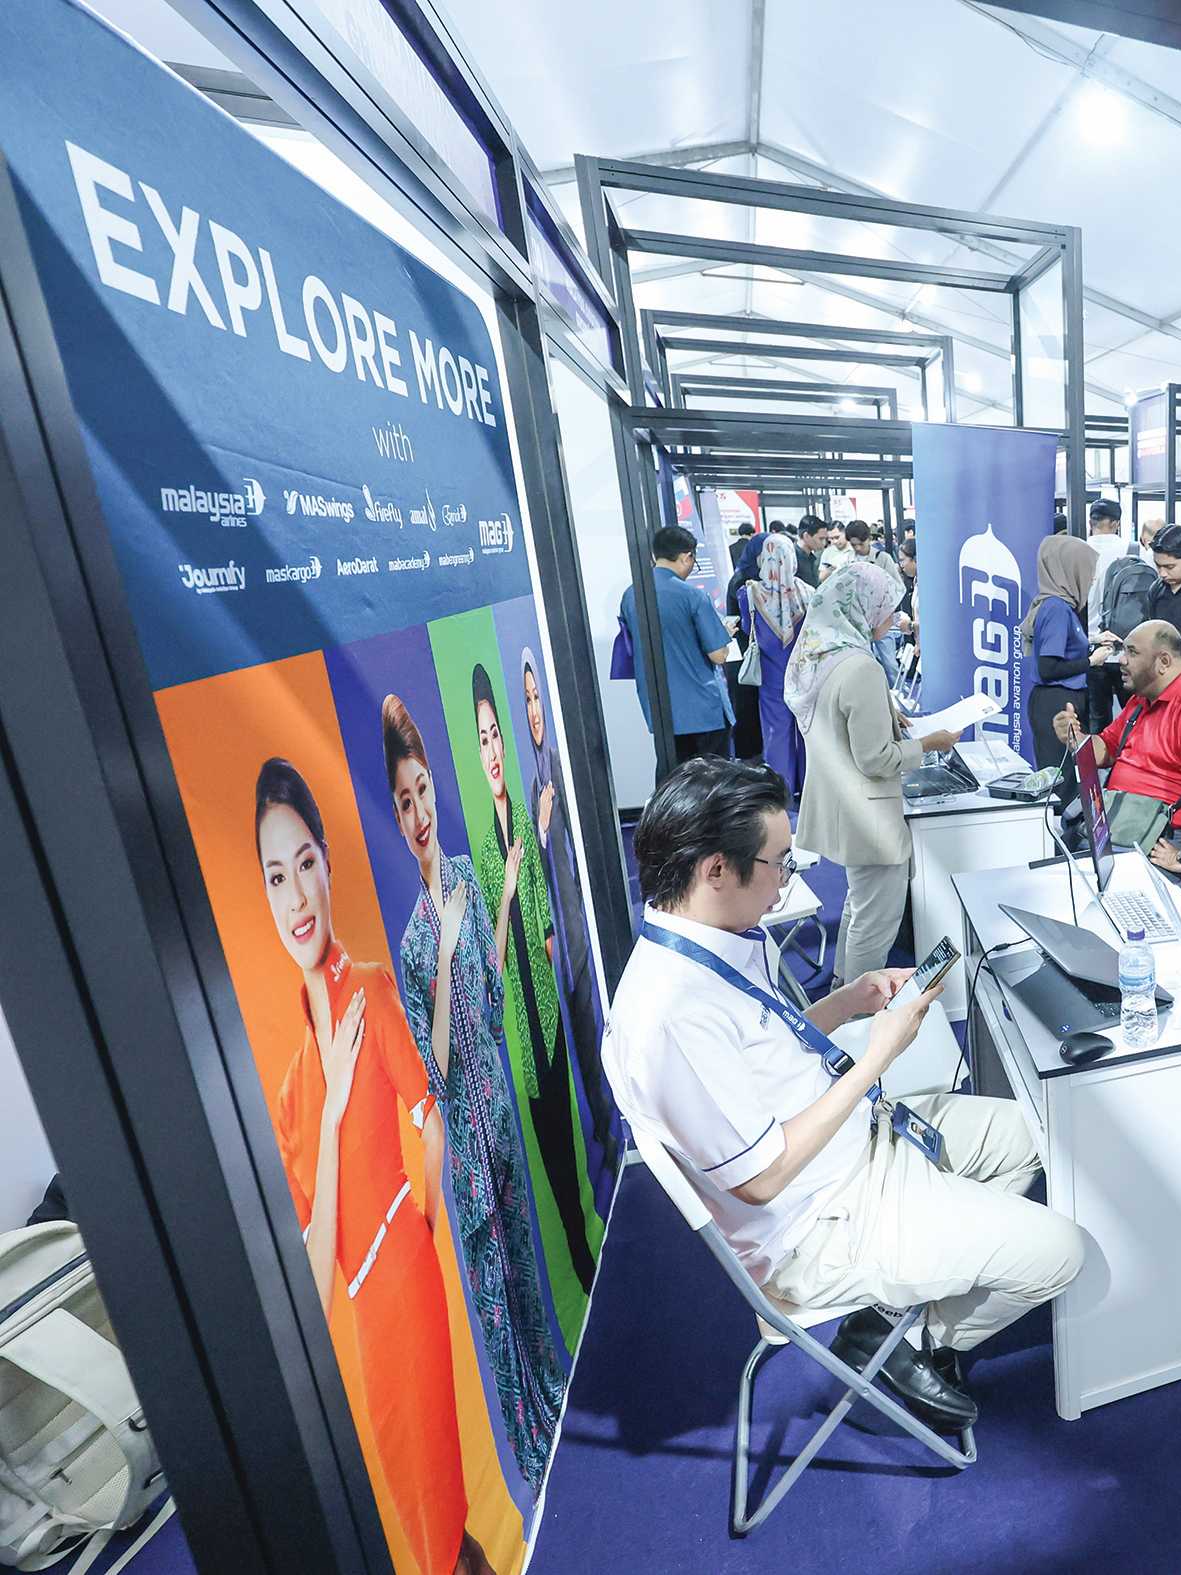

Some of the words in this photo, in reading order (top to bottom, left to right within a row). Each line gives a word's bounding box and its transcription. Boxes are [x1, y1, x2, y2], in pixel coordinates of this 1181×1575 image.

[65, 140, 408, 398] EXPLORE
[408, 329, 497, 428] MORE
[372, 422, 415, 463] with
[160, 485, 246, 522] malaysia
[300, 493, 355, 524] MASwings
[265, 564, 312, 584] maskargo
[336, 556, 379, 576] AeroDarat
[1012, 624, 1024, 660] group
